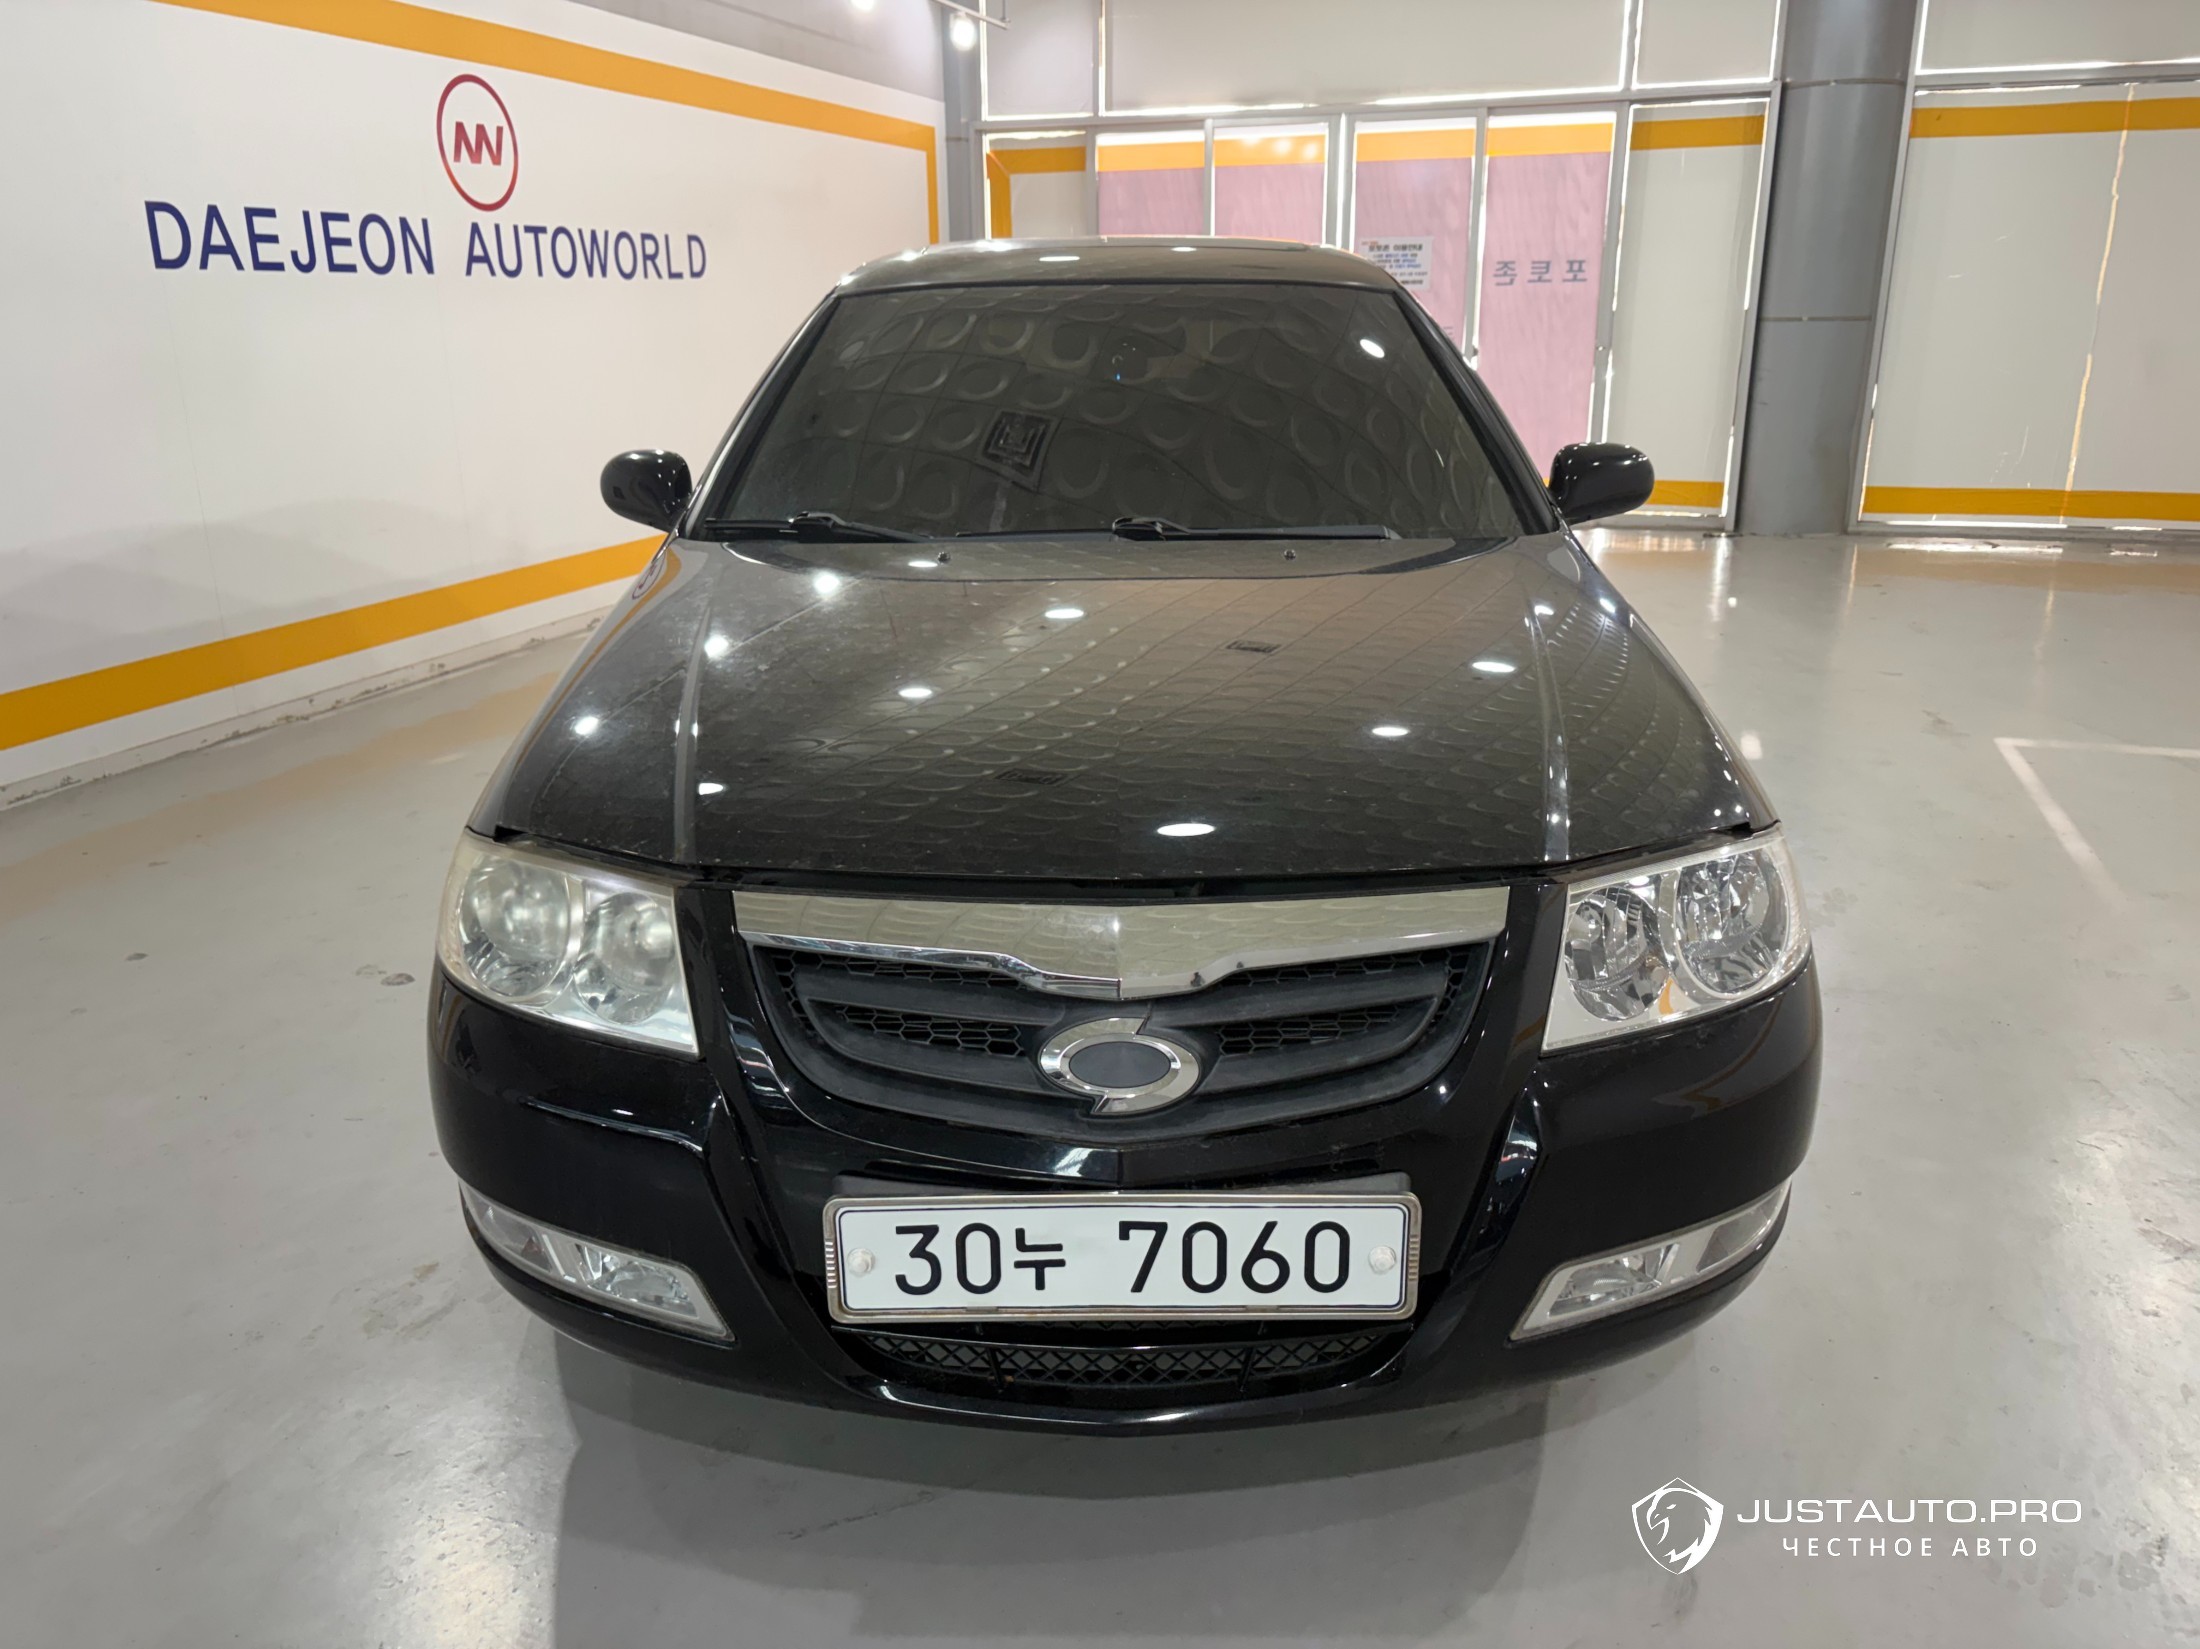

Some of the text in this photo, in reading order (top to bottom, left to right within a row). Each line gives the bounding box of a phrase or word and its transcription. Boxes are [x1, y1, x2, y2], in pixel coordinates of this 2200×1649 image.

[145, 200, 707, 281] DAEJEON AUTOWORLD
[894, 1220, 1351, 1295] 30누 7060
